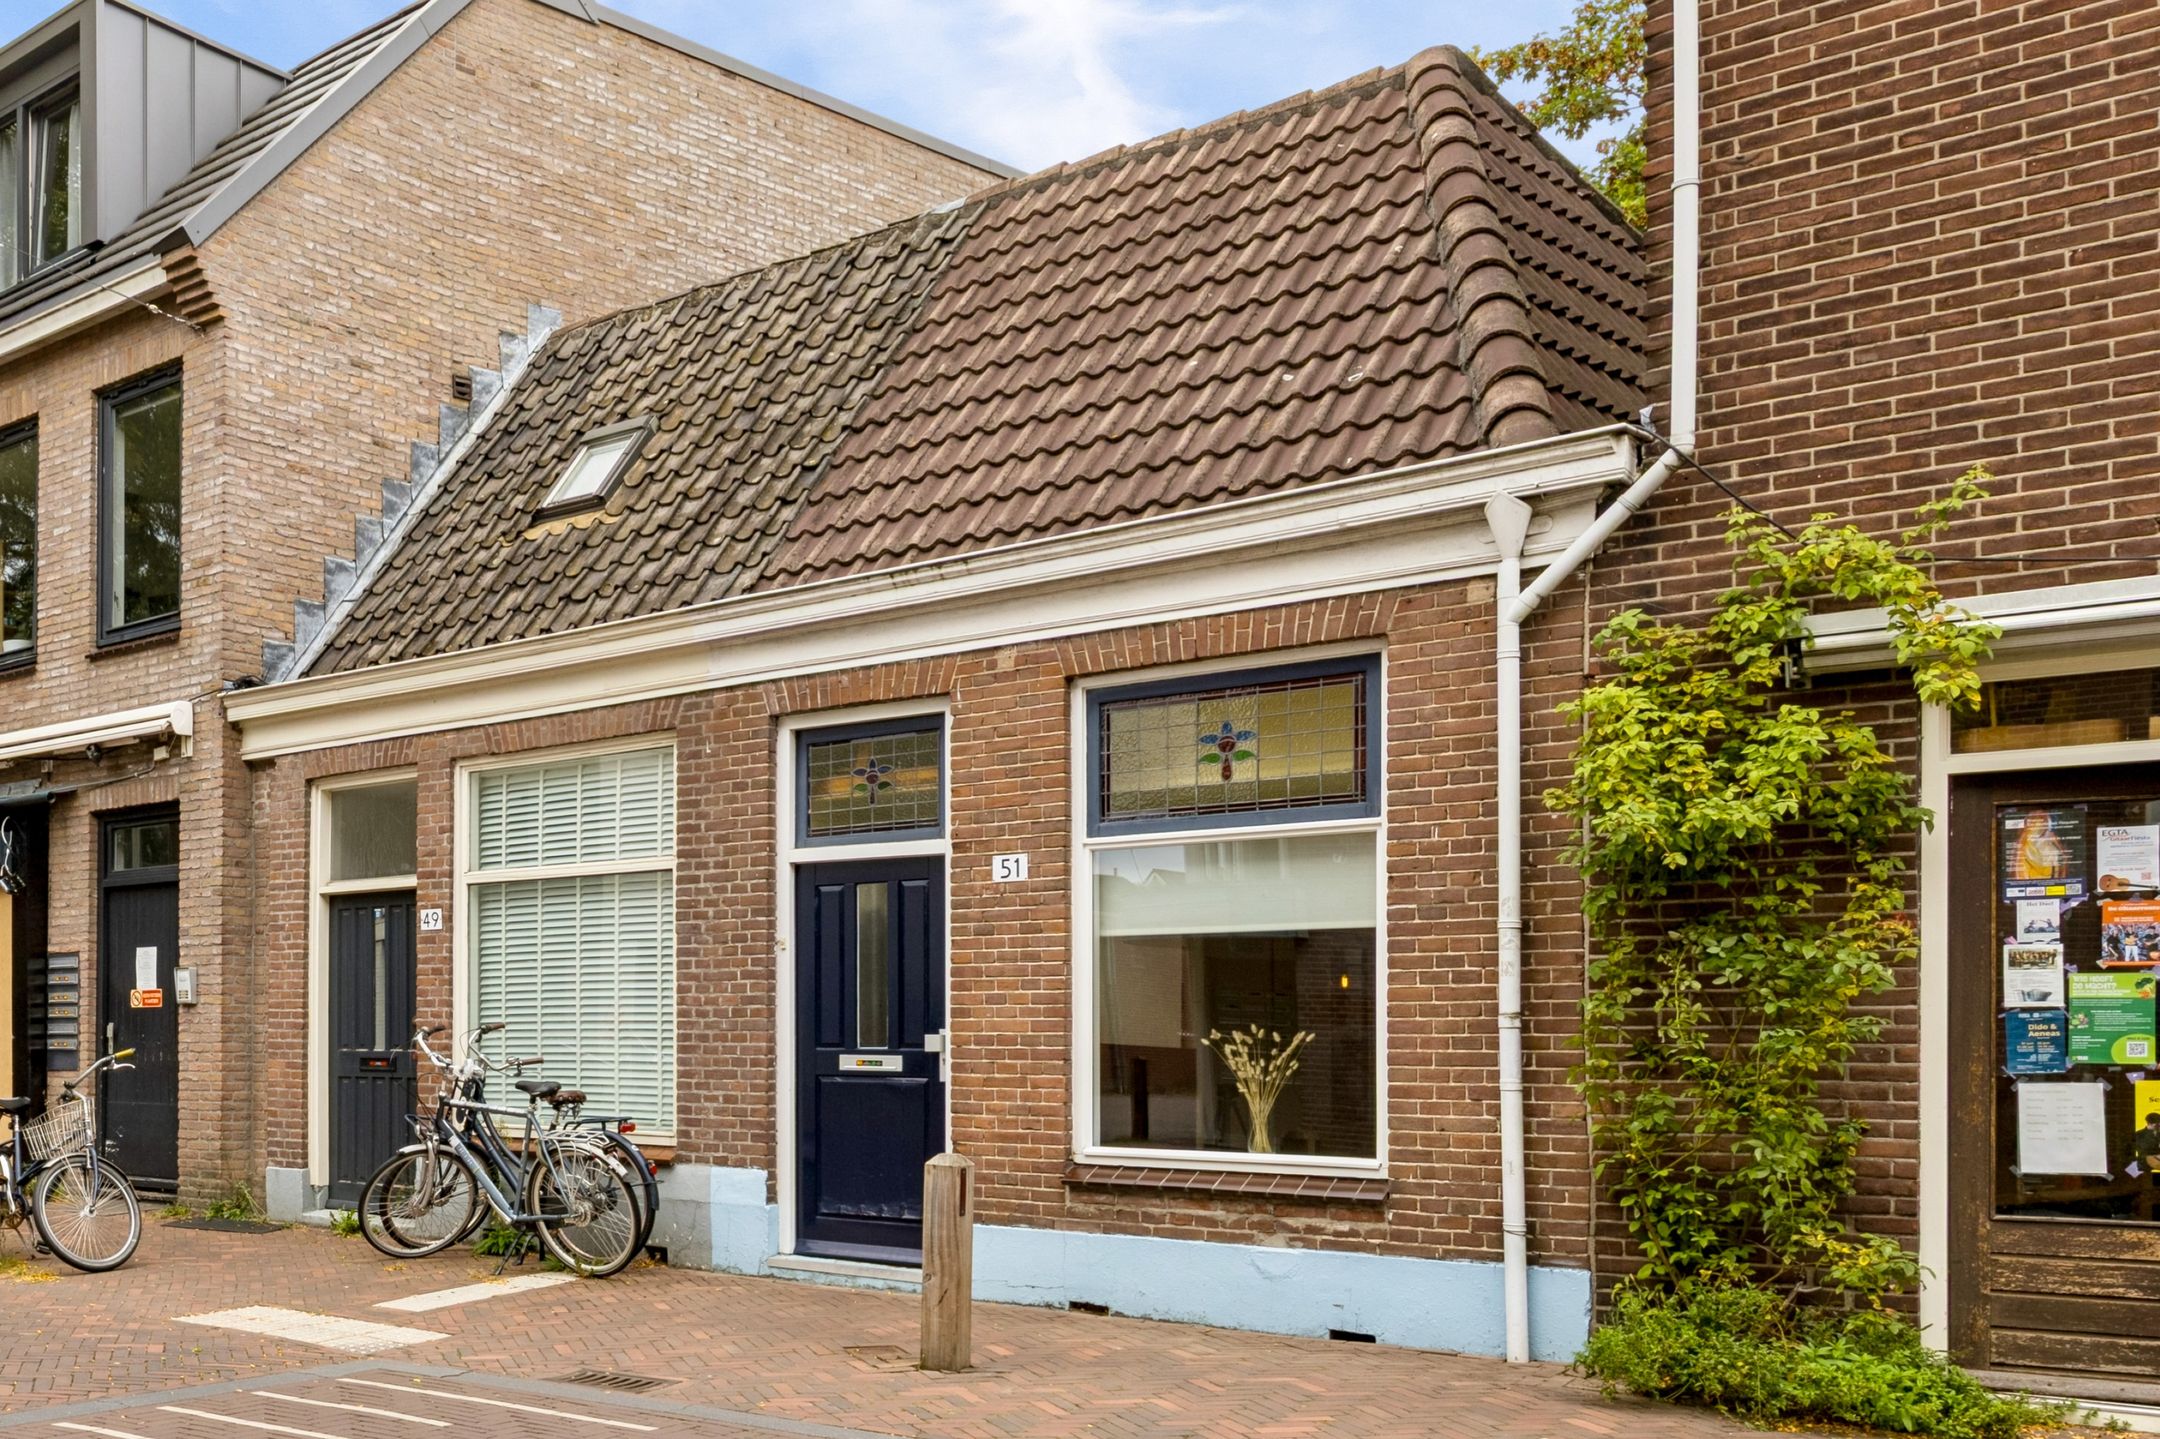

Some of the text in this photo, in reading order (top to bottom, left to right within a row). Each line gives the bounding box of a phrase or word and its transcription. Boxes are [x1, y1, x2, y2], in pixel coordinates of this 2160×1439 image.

[2102, 829, 2128, 837] EGTA
[1001, 857, 1020, 879] 51
[423, 911, 439, 928] 49
